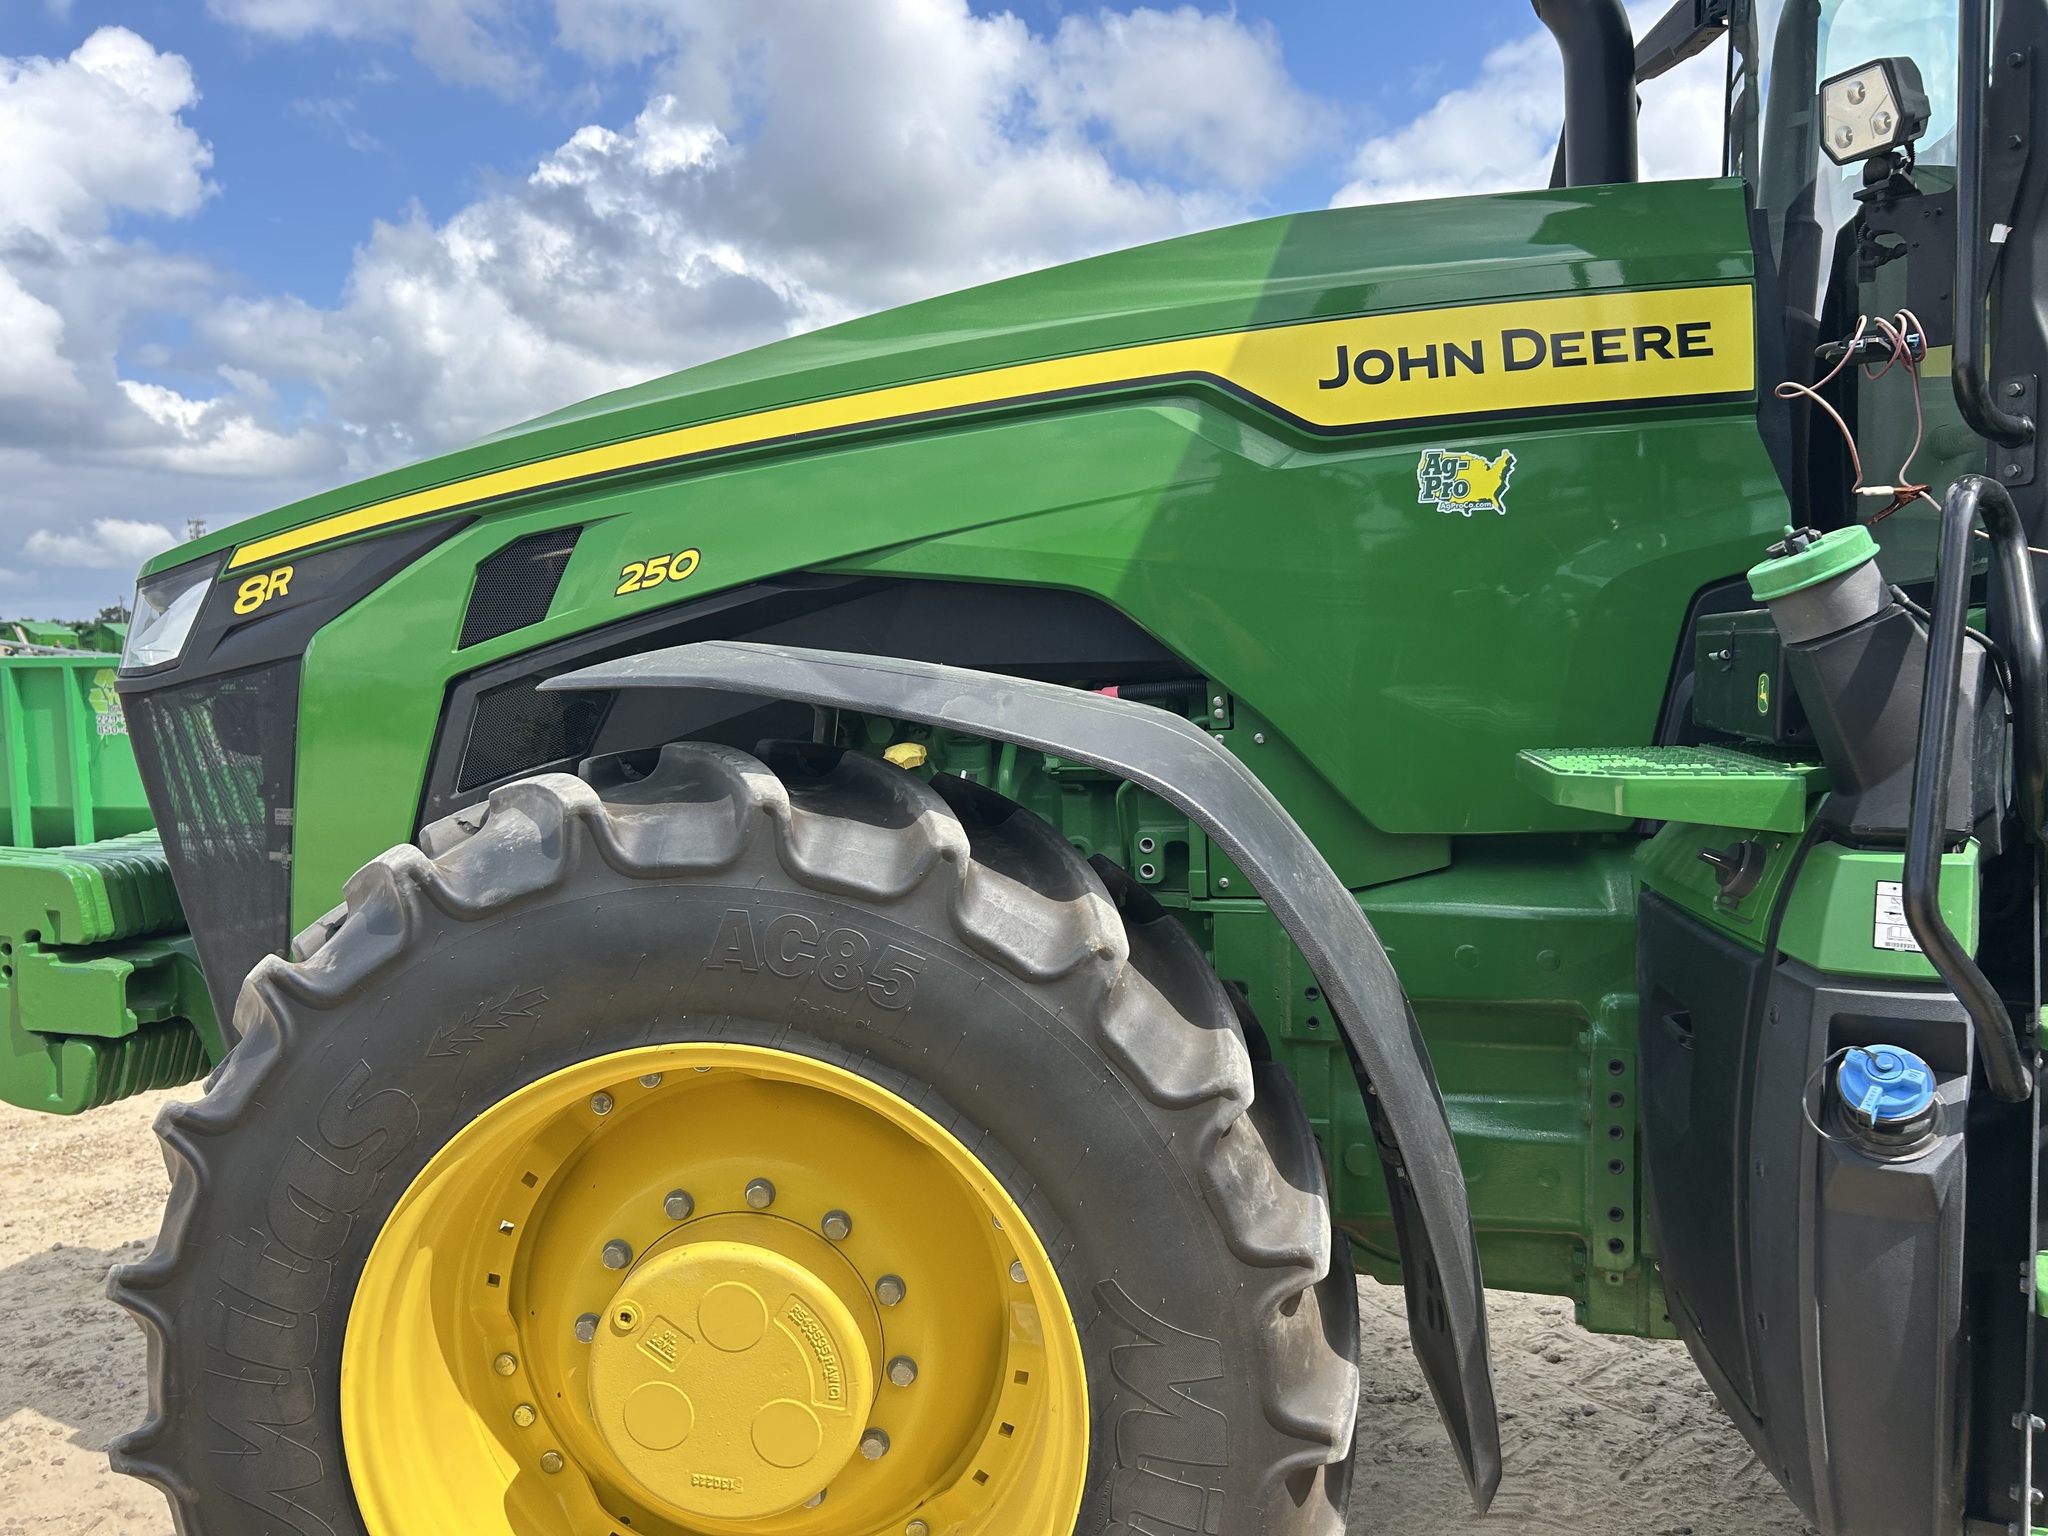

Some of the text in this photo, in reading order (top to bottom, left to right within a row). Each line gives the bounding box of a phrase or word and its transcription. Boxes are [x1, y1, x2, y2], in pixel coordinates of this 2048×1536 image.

[1318, 321, 1714, 390] JOHN DEERE
[1422, 452, 1470, 480] Ag-
[1422, 476, 1470, 501] Pro
[1439, 501, 1494, 511] AgProCo.com
[233, 565, 294, 615] 8R
[614, 547, 702, 597] 250
[706, 908, 927, 1010] AC85
